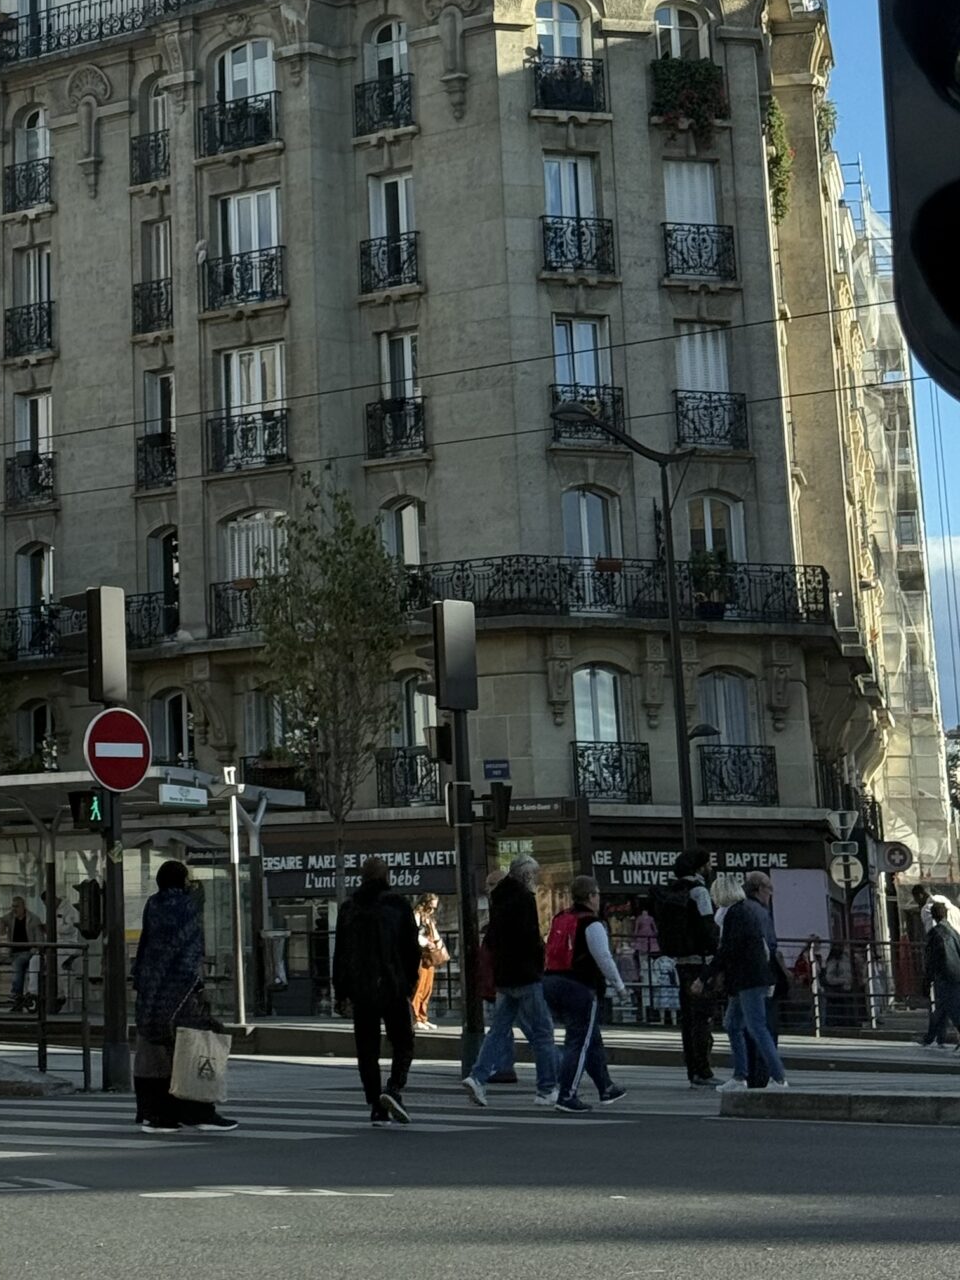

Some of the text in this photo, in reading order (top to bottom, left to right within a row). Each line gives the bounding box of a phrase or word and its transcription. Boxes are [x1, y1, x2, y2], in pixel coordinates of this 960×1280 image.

[308, 853, 357, 869] MARIGE
[725, 852, 788, 868] BAPTEME
[305, 869, 421, 889] L'uniers bébé
